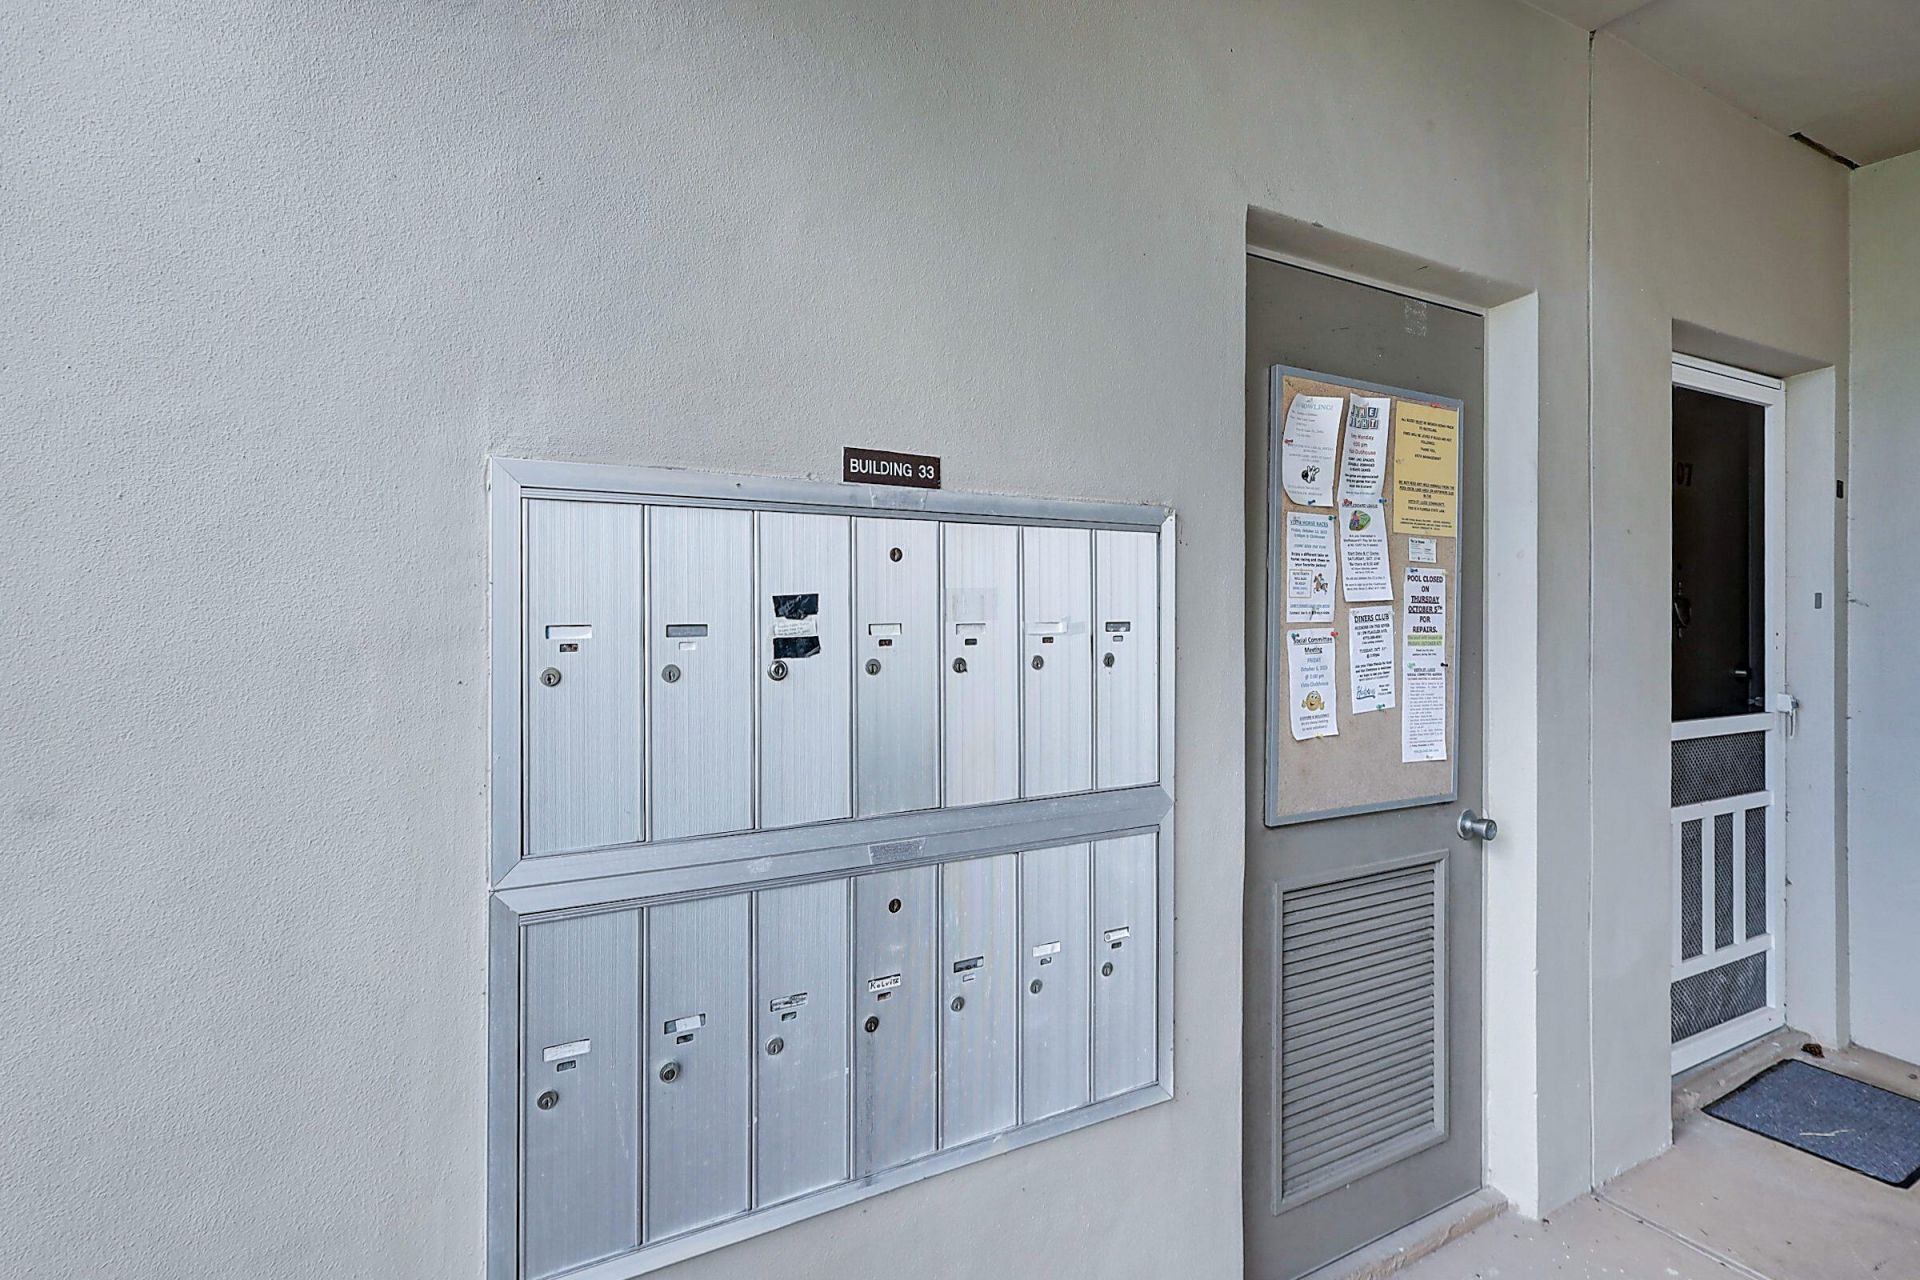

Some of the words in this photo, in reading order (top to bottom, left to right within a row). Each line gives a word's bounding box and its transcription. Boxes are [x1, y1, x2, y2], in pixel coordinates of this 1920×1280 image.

[849, 458, 913, 478] BUILDING
[918, 464, 935, 479] 33
[1407, 574, 1422, 582] POOL
[1422, 575, 1444, 583] CLOSED
[1410, 595, 1440, 604] THURSDAY
[1407, 605, 1433, 614] OCTOBER
[1354, 614, 1373, 623] DINERS
[1374, 613, 1389, 621] CLUB
[1419, 615, 1431, 623] FOR
[1412, 625, 1438, 633] REPAIRS.
[1308, 636, 1332, 644] Committee
[1304, 646, 1323, 655] Meeting
